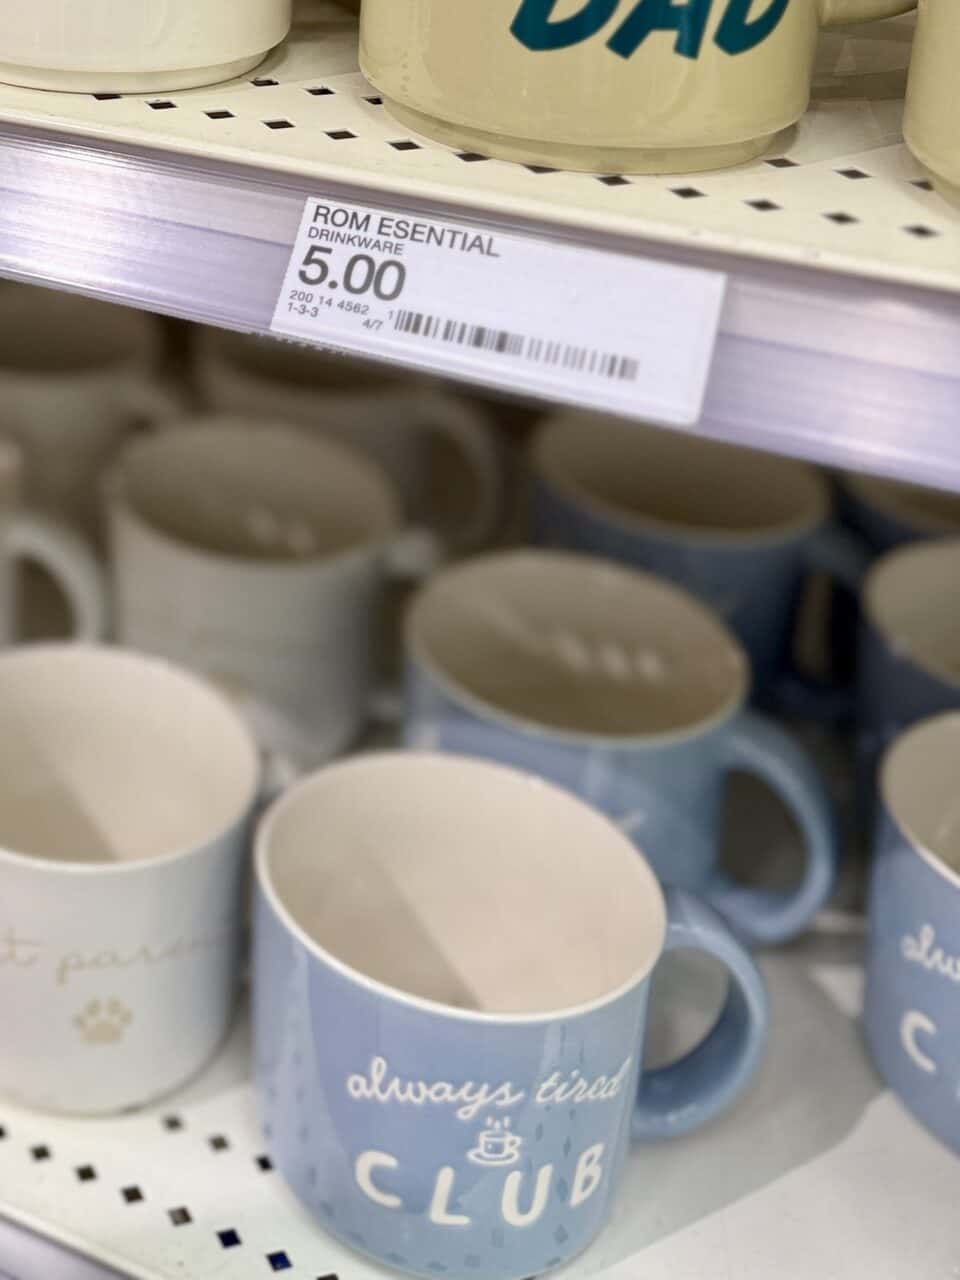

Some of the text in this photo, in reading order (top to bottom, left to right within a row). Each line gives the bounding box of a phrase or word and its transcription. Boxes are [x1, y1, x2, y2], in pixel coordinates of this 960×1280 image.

[308, 227, 406, 256] DRINKWARE
[311, 205, 500, 258] ROM ESENTIAL
[298, 245, 406, 302] 5.00
[287, 302, 319, 319] 1-3-3
[289, 289, 370, 316] 200 14 4562
[347, 1054, 525, 1120] always
[354, 1142, 606, 1228] CLUB
